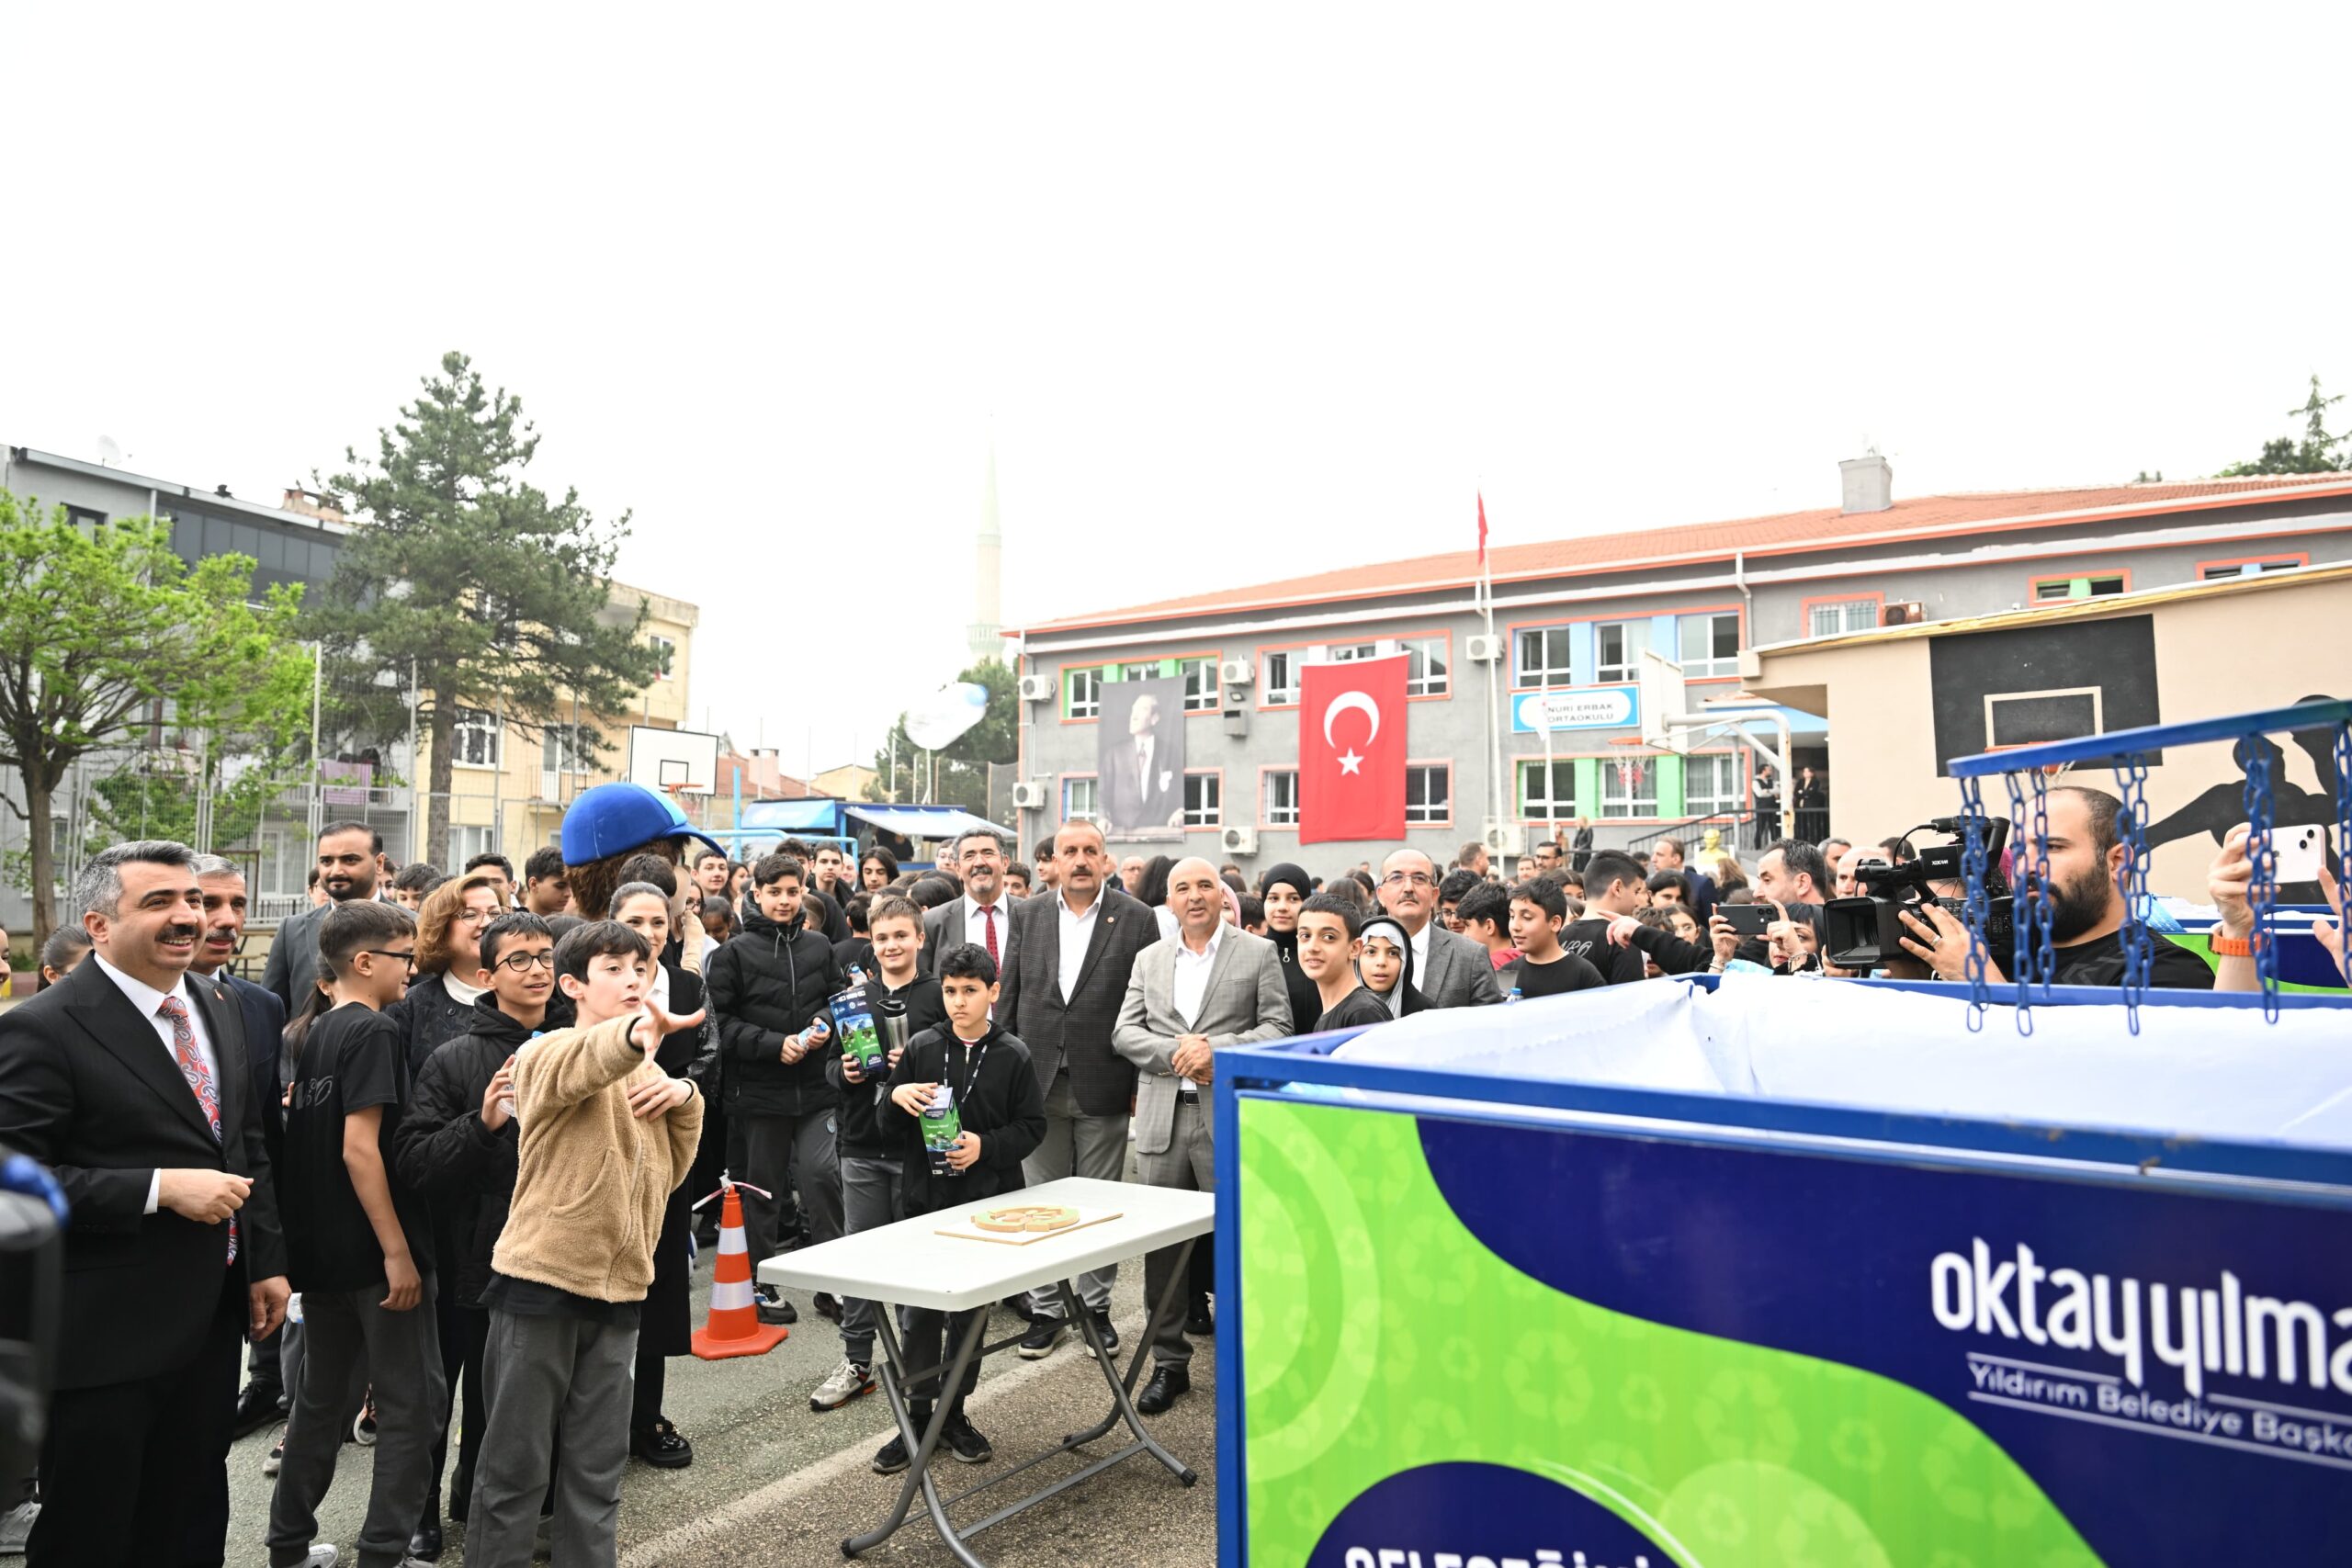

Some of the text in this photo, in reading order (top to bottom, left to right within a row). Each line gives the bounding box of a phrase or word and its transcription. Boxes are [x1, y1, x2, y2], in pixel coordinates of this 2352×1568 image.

[1577, 703, 1614, 712] ERBAK
[1547, 713, 1614, 723] ORTAOKULU
[1968, 1361, 2089, 1409] Yıldırım
[2097, 1383, 2244, 1436] Belediye
